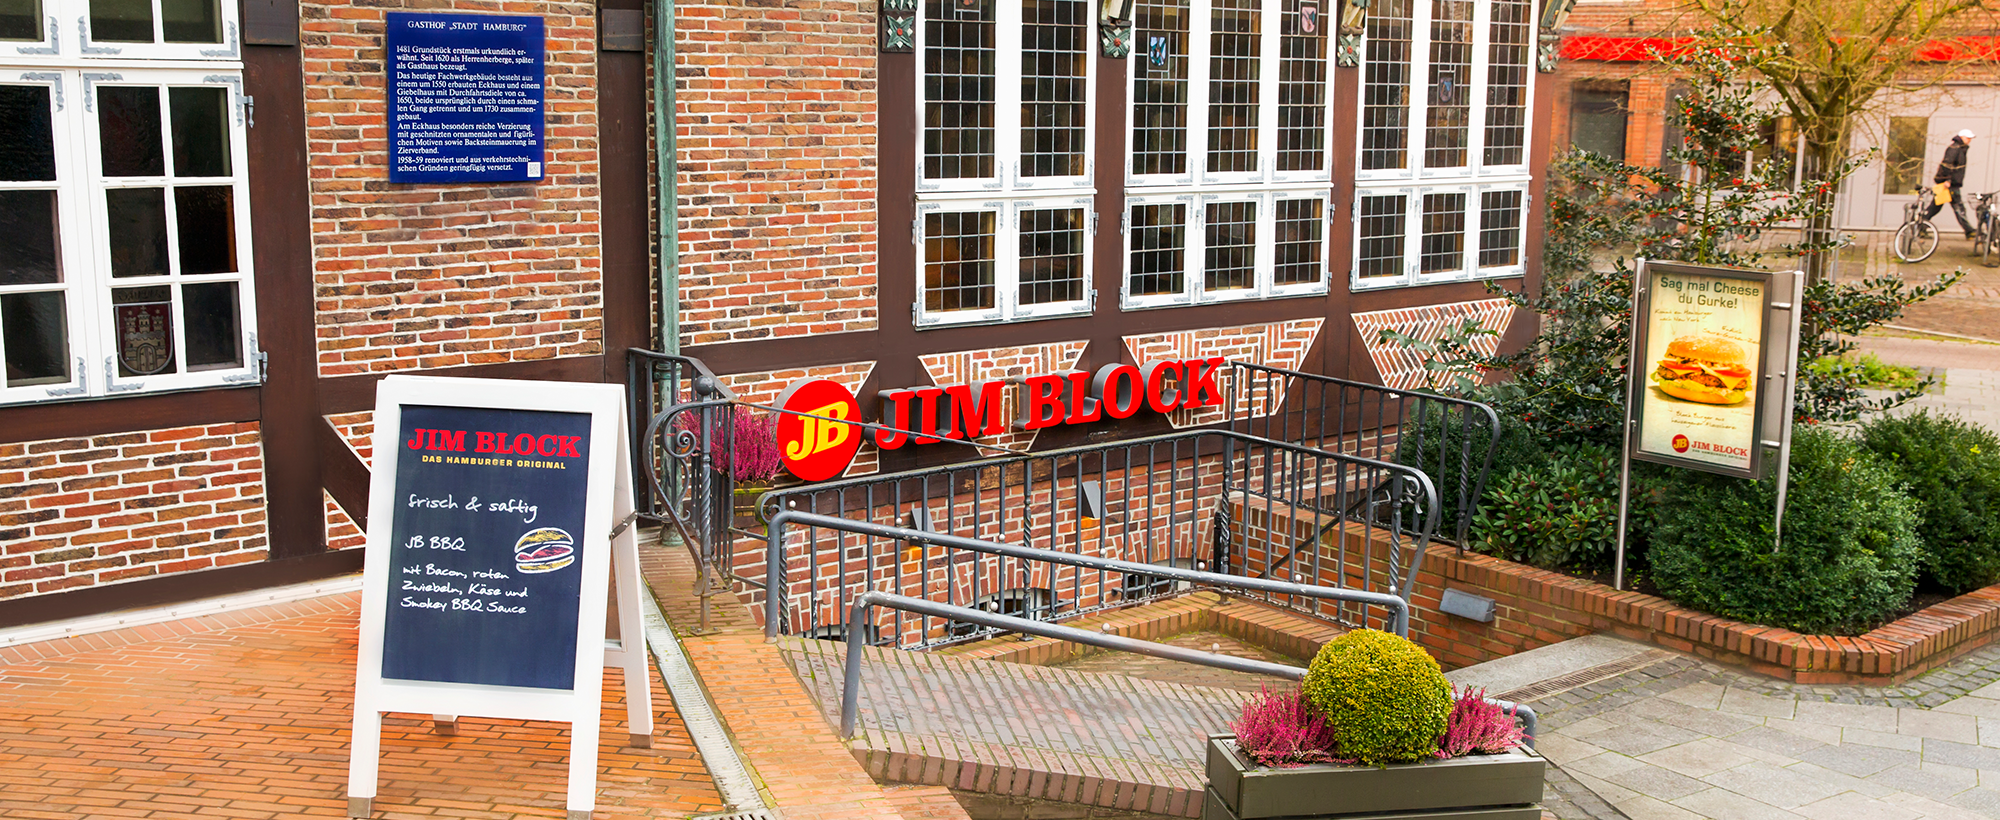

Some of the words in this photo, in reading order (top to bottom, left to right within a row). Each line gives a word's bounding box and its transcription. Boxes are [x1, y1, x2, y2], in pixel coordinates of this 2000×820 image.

[408, 20, 446, 30] GASTHOF
[396, 45, 411, 53] 1481
[412, 46, 451, 54] Grundstück
[453, 47, 480, 55] erstmals
[481, 47, 516, 56] urkundlich
[396, 53, 419, 61] wähnt.
[421, 54, 434, 62] Seit
[451, 55, 460, 63] als
[461, 55, 514, 65] Herrenherberge,
[515, 57, 534, 65] später
[396, 62, 406, 70] als
[407, 62, 438, 70] Gasthaus
[440, 63, 468, 72] bezeugt.
[396, 71, 410, 80] Das
[411, 72, 437, 82] heutige
[437, 72, 497, 82] Fachwerkgebäude
[396, 80, 418, 88] einem
[447, 81, 477, 89] erbauten
[478, 81, 506, 89] Eckhaus
[506, 82, 520, 90] und
[520, 82, 541, 90] einem
[396, 88, 435, 97] Giebelhaus
[436, 89, 448, 97] mit
[449, 89, 504, 98] Durchfahrtsdiele
[396, 96, 414, 105] 1650,
[415, 97, 434, 105] beide
[435, 97, 476, 106] ursprünglich
[477, 97, 497, 105] durch
[497, 98, 516, 106] einen
[516, 98, 540, 106] schma-
[396, 104, 408, 112] len
[409, 104, 428, 114] Gang
[428, 105, 457, 114] getrennt
[457, 105, 471, 113] und
[484, 105, 499, 113] 1730
[396, 112, 422, 122] gebaut.
[397, 122, 411, 130] Am
[412, 122, 441, 130] Eckhaus
[441, 122, 475, 130] besonders
[475, 122, 496, 130] reiche
[496, 122, 531, 132] Verzierung
[397, 130, 409, 138] mit
[410, 130, 452, 140] geschnitzten
[513, 130, 535, 140] figürli-
[397, 138, 415, 146] chen
[415, 138, 444, 146] Motiven
[444, 138, 464, 146] sowie
[464, 138, 527, 148] Backsteinmauerung
[527, 138, 537, 146] im
[397, 146, 440, 155] Zierverband.
[424, 155, 455, 164] renoviert
[455, 155, 469, 163] und
[482, 155, 531, 163] verkehrstechni-
[397, 164, 418, 172] schen
[418, 164, 449, 172] Gründen
[449, 163, 486, 173] geringfügig
[1660, 277, 1682, 292] Sag
[1687, 281, 1709, 291] mal
[1714, 282, 1759, 296] Cheese
[1679, 293, 1692, 304] du
[1698, 295, 1737, 309] Gurke!
[875, 380, 1006, 450] JIM
[1024, 356, 1226, 430] BLOCK
[787, 401, 850, 461] JB
[407, 428, 467, 452] JIM
[474, 431, 581, 457] BLOCK
[1673, 438, 1687, 449] JB
[1691, 441, 1710, 450] JIM
[1713, 444, 1748, 456] BLOCK
[422, 455, 442, 463] DAS
[447, 456, 513, 467] HAMBURGER
[517, 460, 566, 469] ORIGINAL
[408, 494, 458, 509] frisch
[465, 496, 482, 512] &
[489, 499, 538, 523] saftig
[405, 535, 425, 550] JB
[430, 536, 466, 551] BBQ
[403, 565, 421, 575] mit
[425, 563, 468, 579] Bacon,
[473, 569, 509, 579] roten
[401, 580, 463, 595] Zwiebeln,
[467, 583, 502, 596] Käse
[505, 587, 529, 598] und
[400, 596, 447, 612] Smokey
[452, 599, 484, 612] BBQ
[487, 602, 526, 614] Sauce
